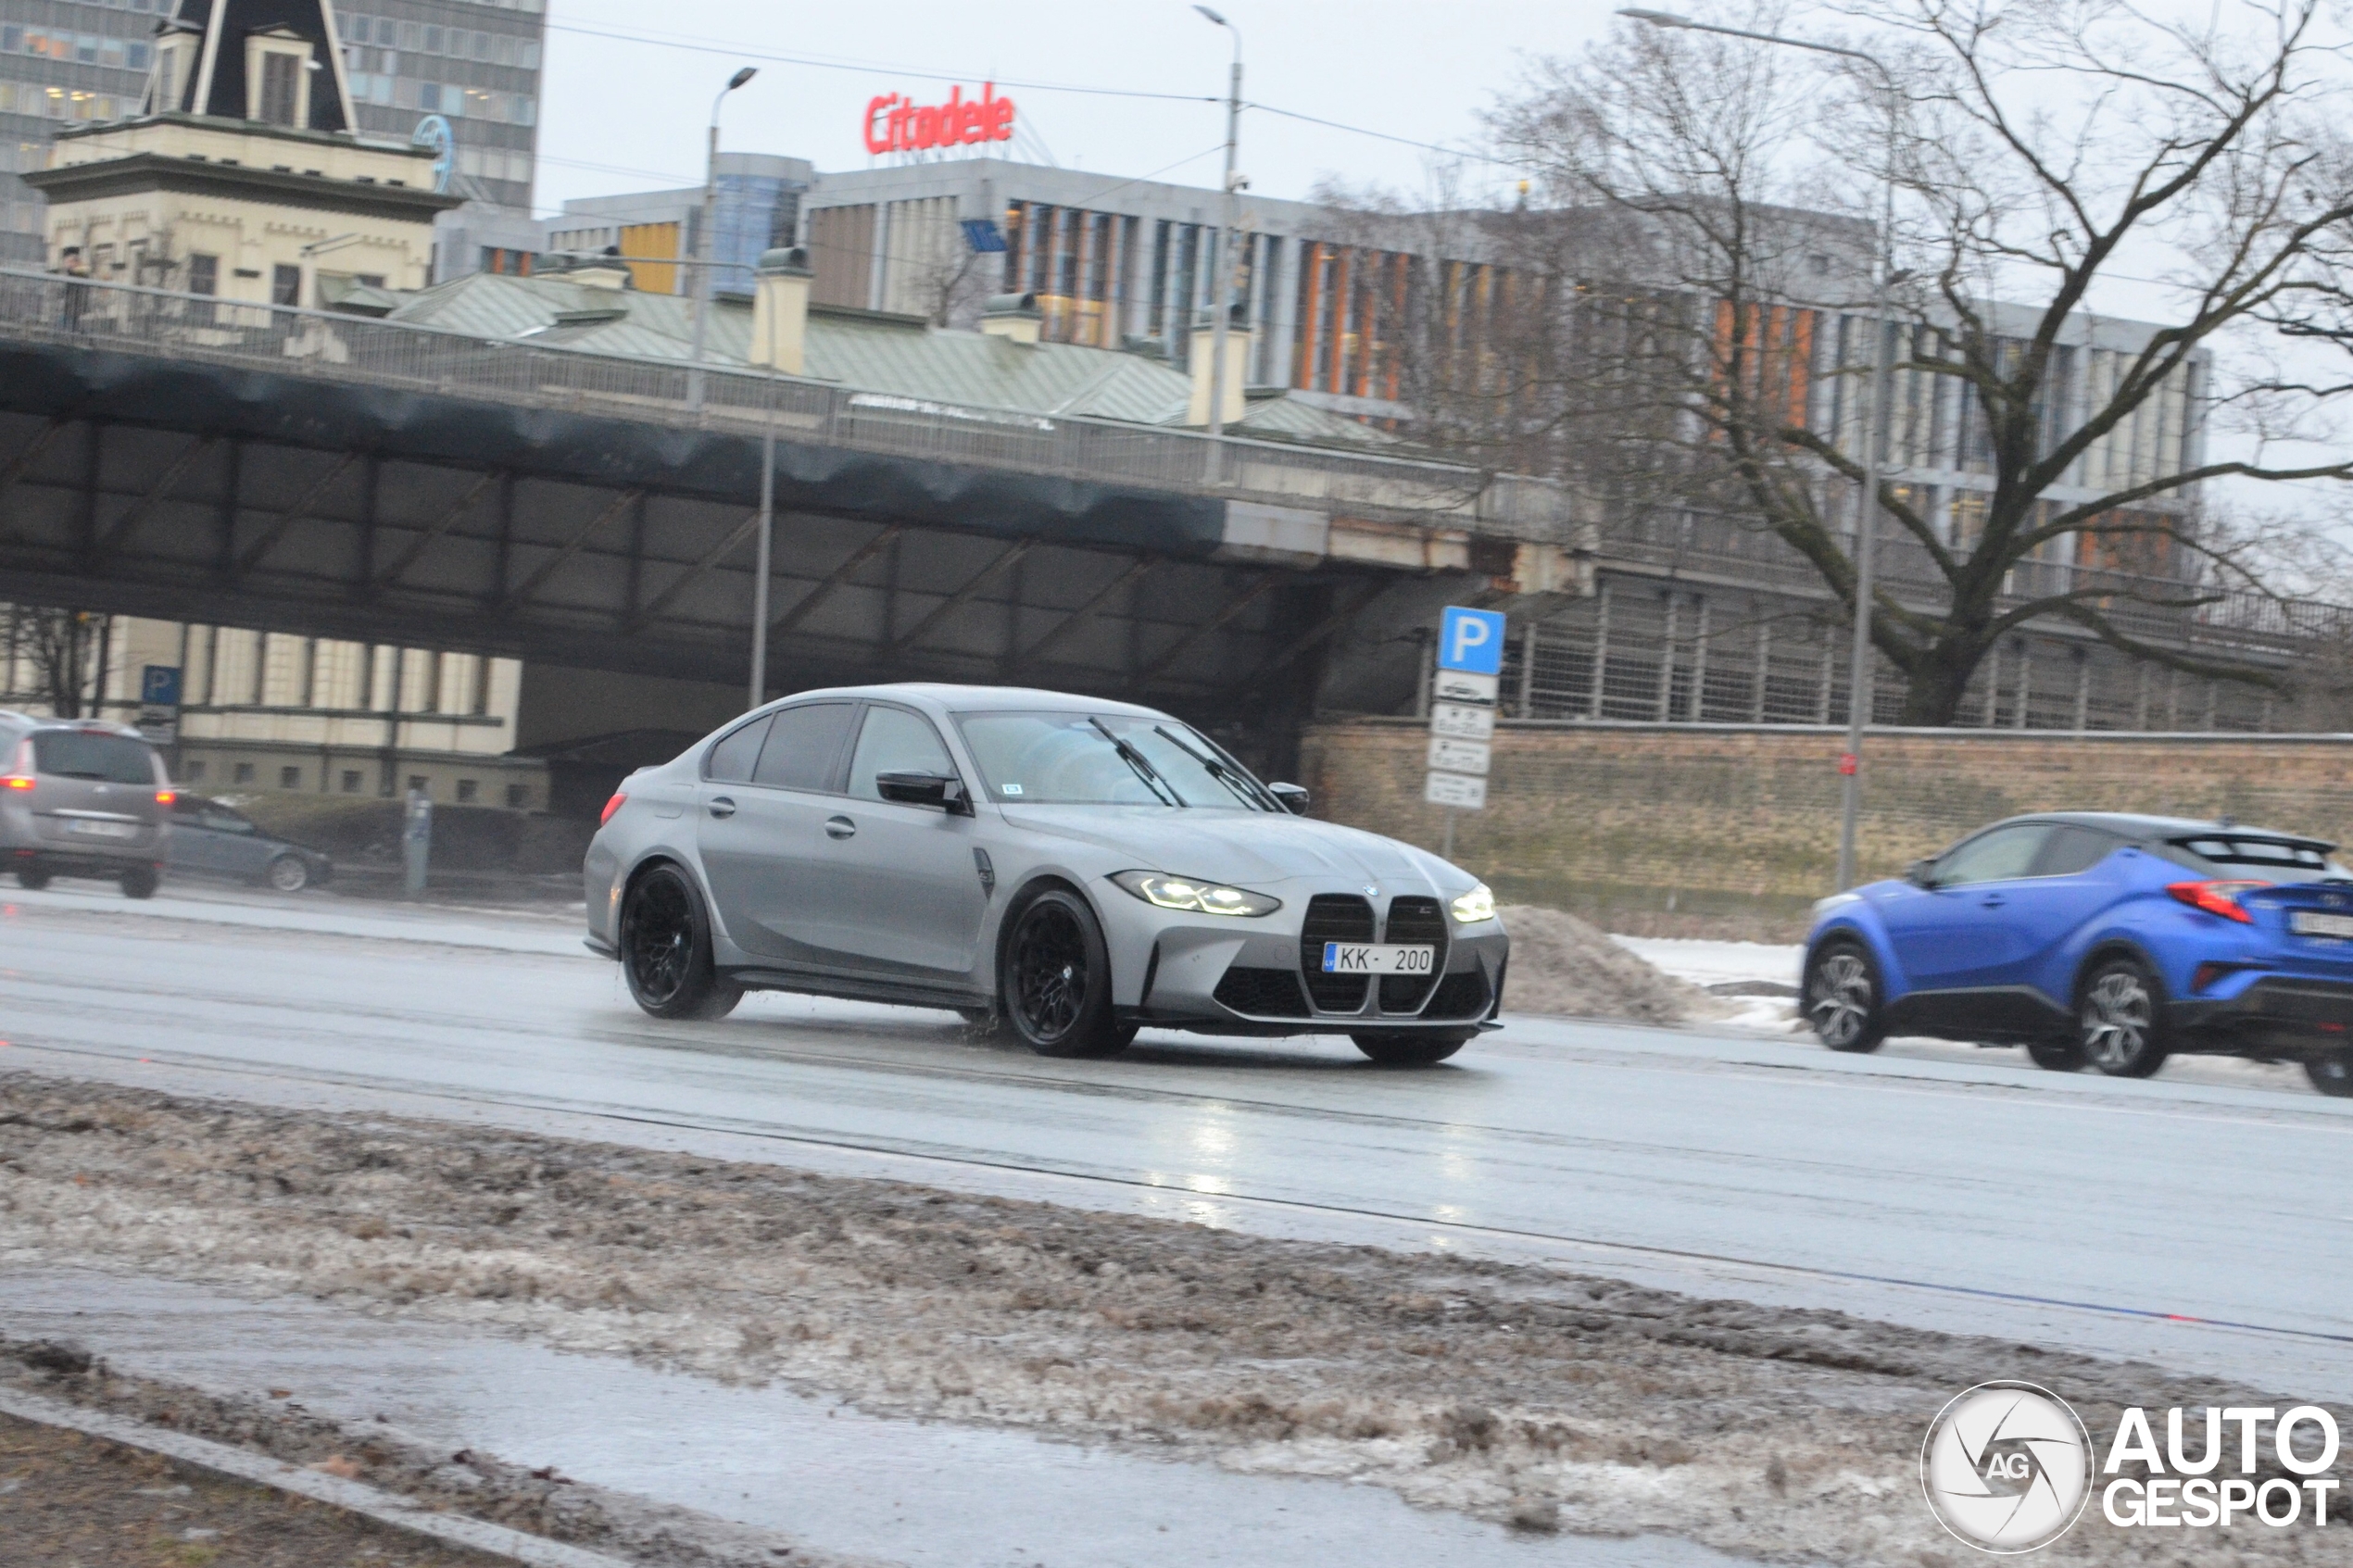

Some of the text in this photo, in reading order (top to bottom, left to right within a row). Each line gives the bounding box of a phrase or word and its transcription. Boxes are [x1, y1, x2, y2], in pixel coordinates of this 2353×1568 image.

[864, 82, 1013, 155] Citadele
[1452, 616, 1490, 662] P
[149, 670, 170, 697] P
[1395, 949, 1430, 971] 200
